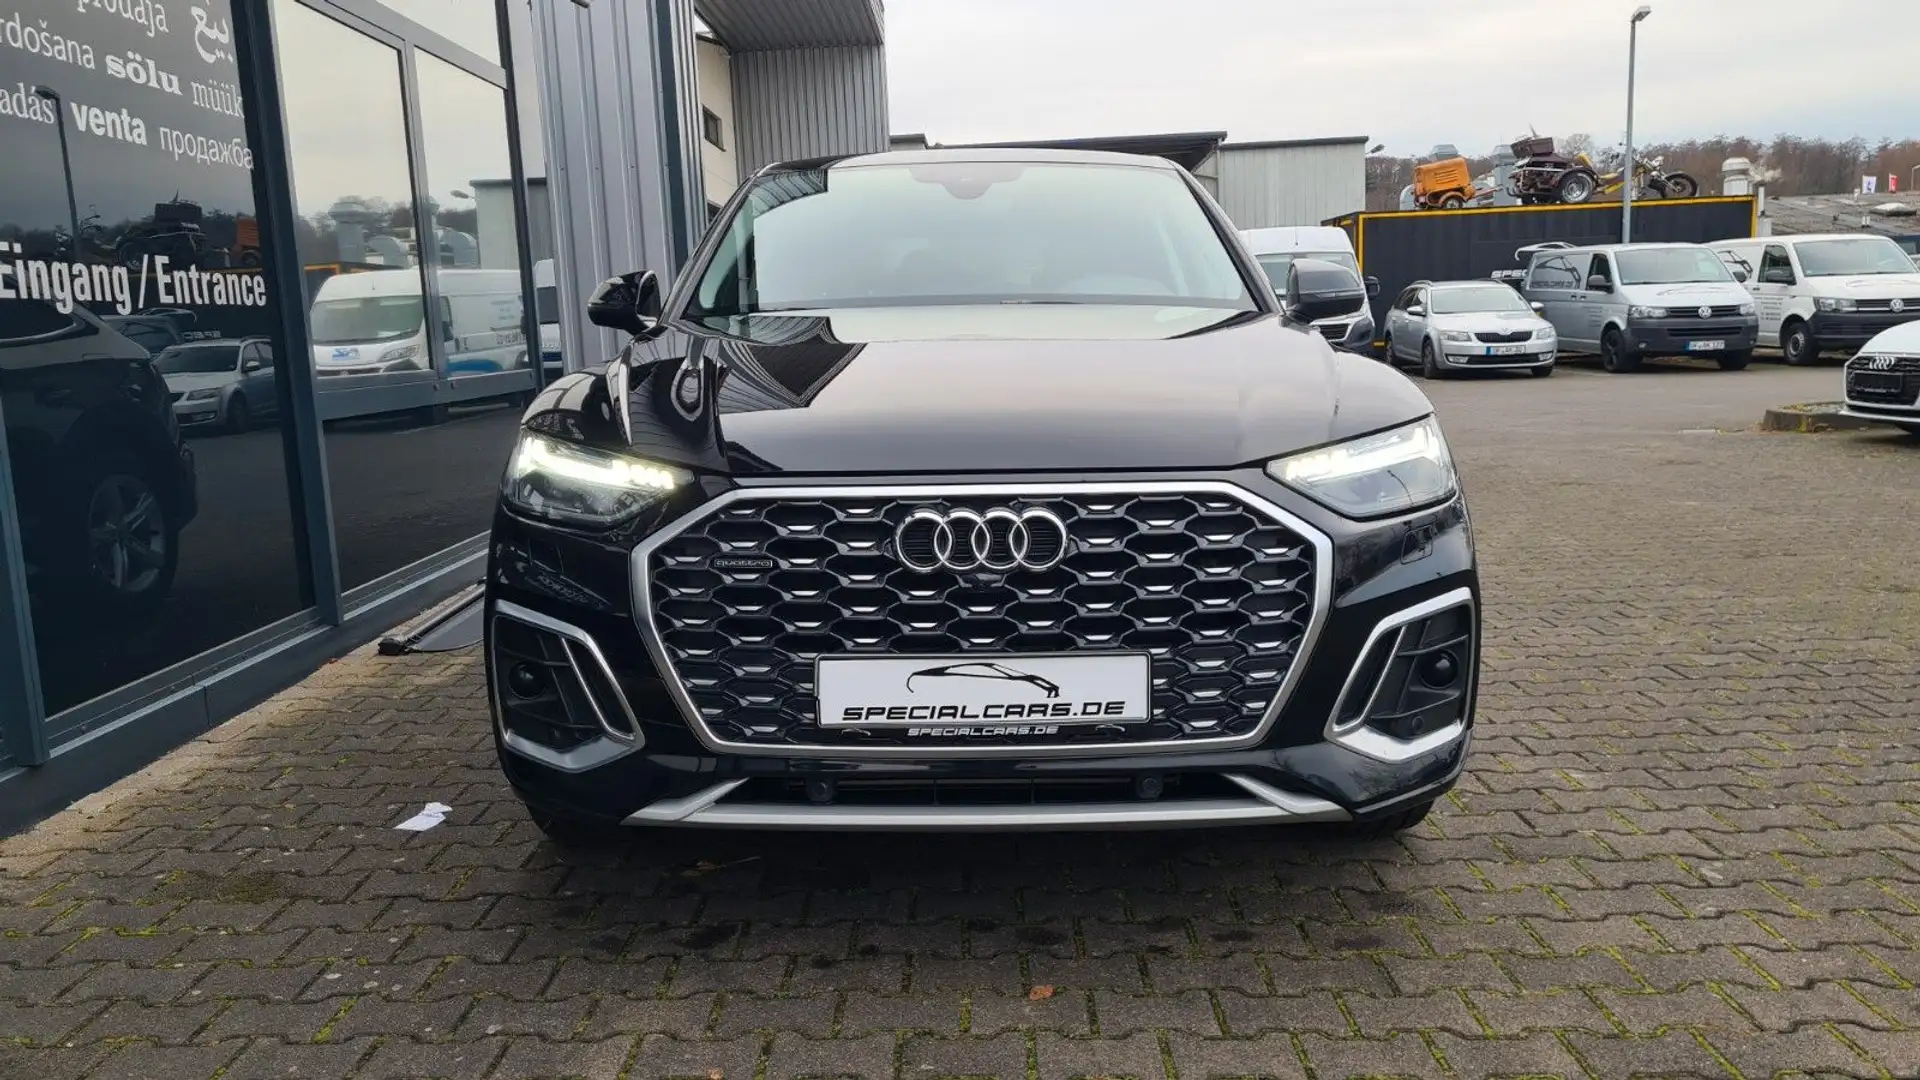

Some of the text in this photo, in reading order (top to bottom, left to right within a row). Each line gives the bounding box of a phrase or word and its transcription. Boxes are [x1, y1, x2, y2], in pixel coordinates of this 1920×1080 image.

[105, 50, 183, 96] sölu
[190, 79, 246, 118] müük
[70, 102, 147, 146] venta
[160, 127, 255, 170] продажба
[154, 254, 267, 307] Entrance
[842, 701, 1126, 721] SPECIALCARS.DE
[907, 726, 1059, 737] SPECIALCARS.DE
